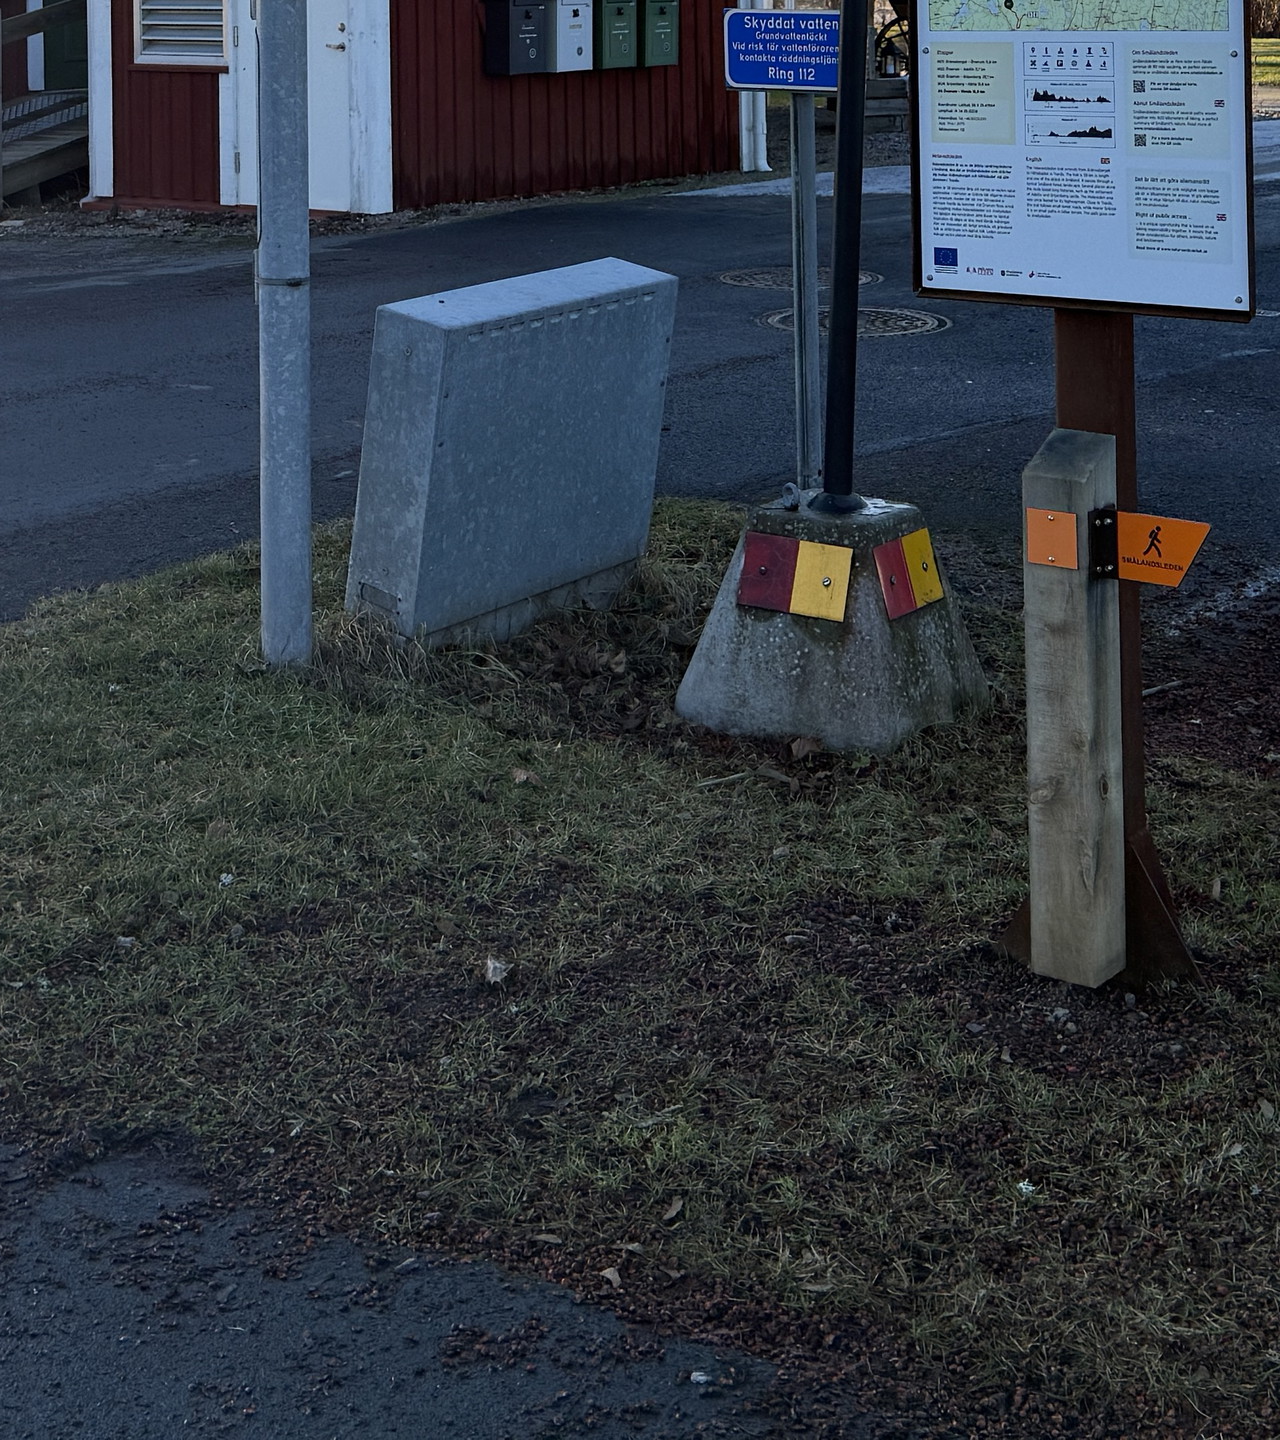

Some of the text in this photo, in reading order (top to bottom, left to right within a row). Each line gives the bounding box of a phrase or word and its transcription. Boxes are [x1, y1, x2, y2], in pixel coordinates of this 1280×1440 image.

[744, 16, 839, 31] Skyddat vatten
[755, 31, 827, 41] Grundvattentäckt
[732, 41, 839, 53] Vid risk för vattenföroren
[739, 53, 839, 65] kontakta räddningstjän
[768, 66, 816, 82] Ring 112
